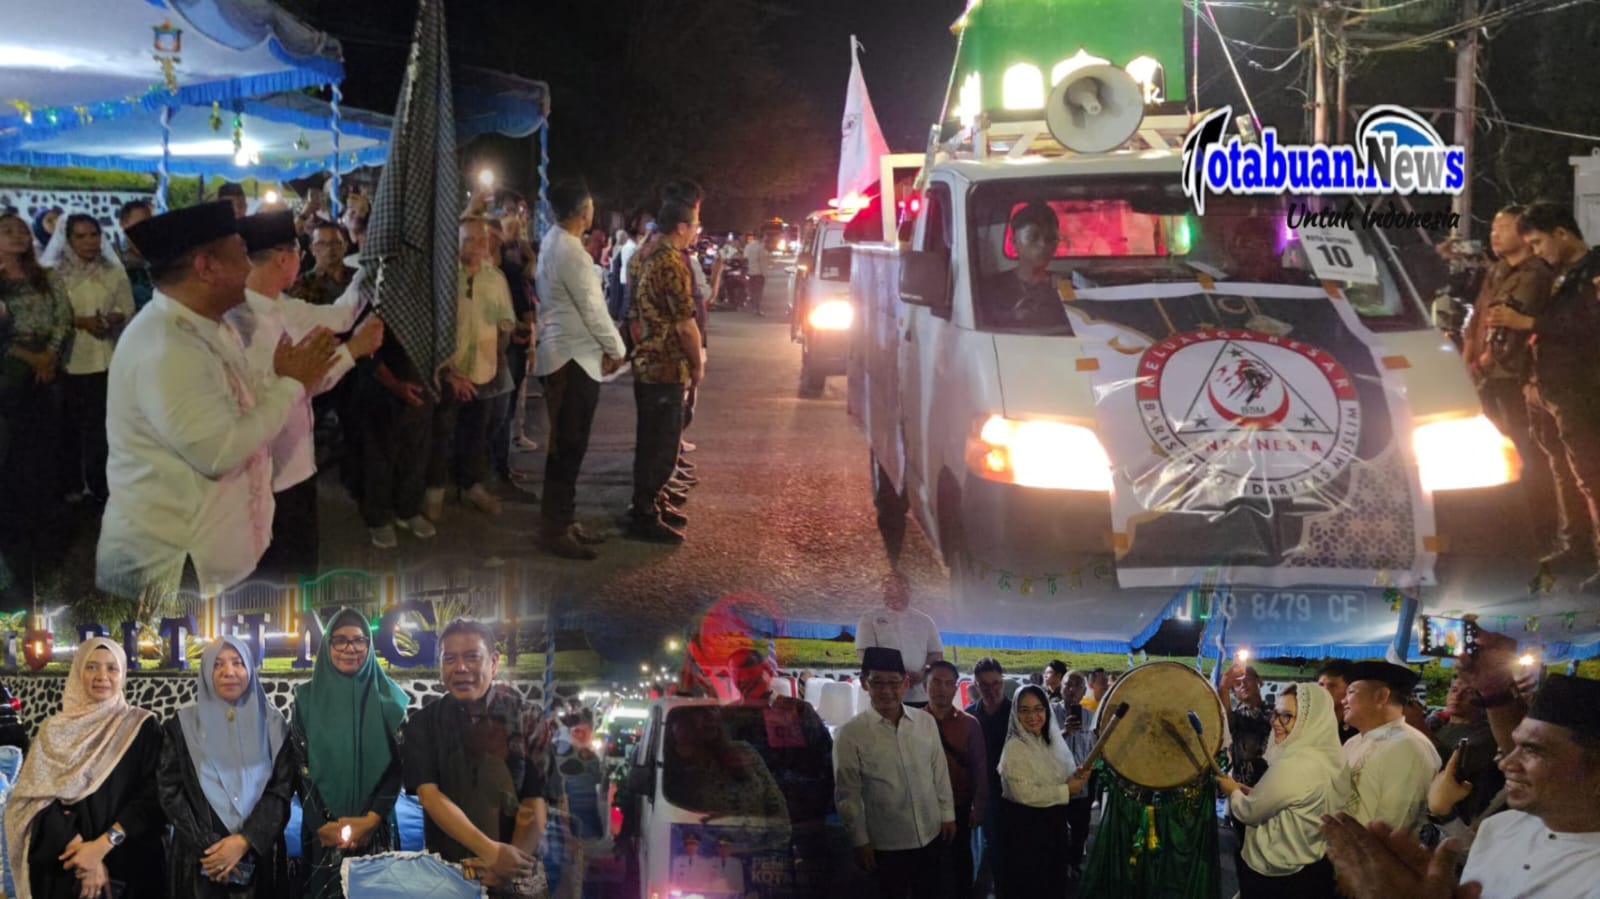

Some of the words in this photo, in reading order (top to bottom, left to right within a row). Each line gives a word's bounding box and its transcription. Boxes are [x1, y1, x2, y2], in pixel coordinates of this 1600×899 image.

[1316, 244, 1354, 268] 10
[1267, 334, 1350, 388] BESAR
[1250, 592, 1313, 622] 8479
[1327, 594, 1361, 624] CF
